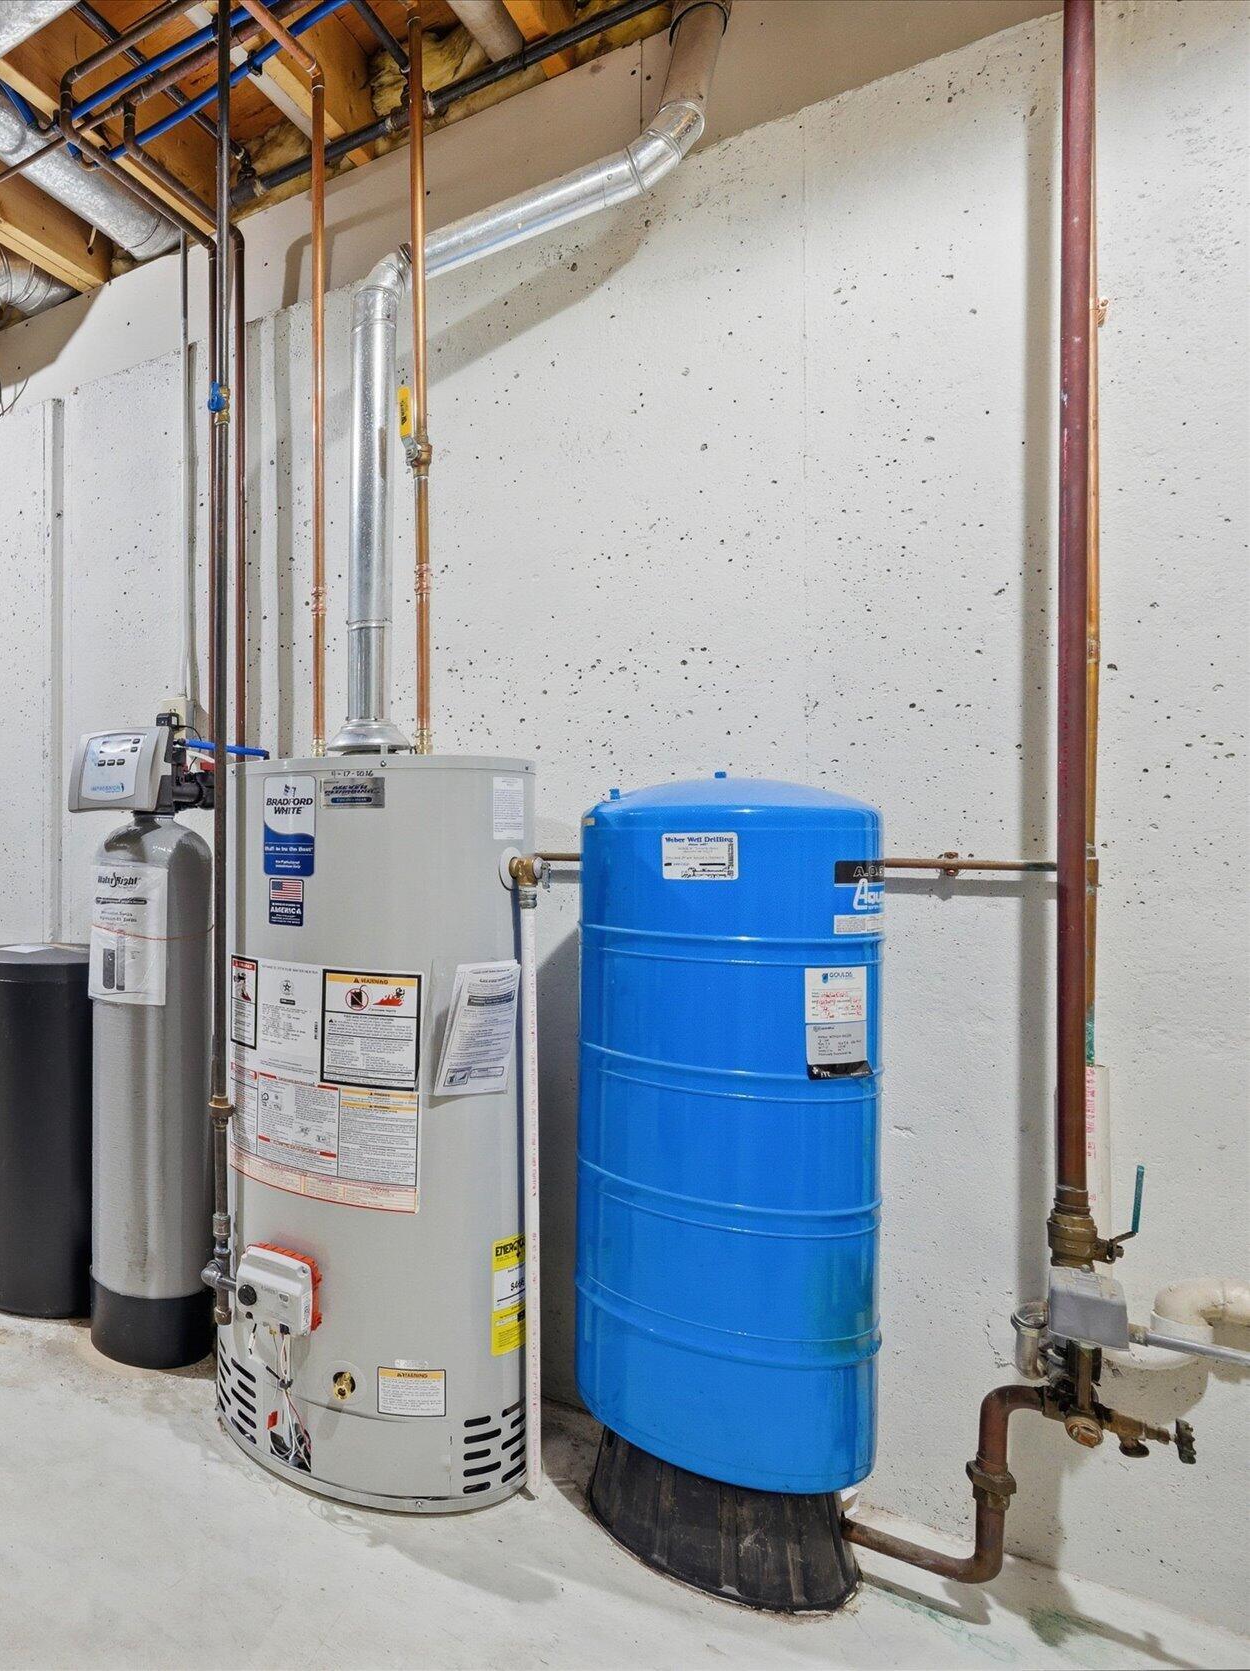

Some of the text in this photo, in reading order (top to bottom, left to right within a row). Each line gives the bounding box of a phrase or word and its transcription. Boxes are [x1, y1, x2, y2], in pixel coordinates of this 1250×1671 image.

[266, 798, 313, 806] BRADFORD
[274, 807, 302, 815] WHITE
[270, 906, 302, 915] AMERICA
